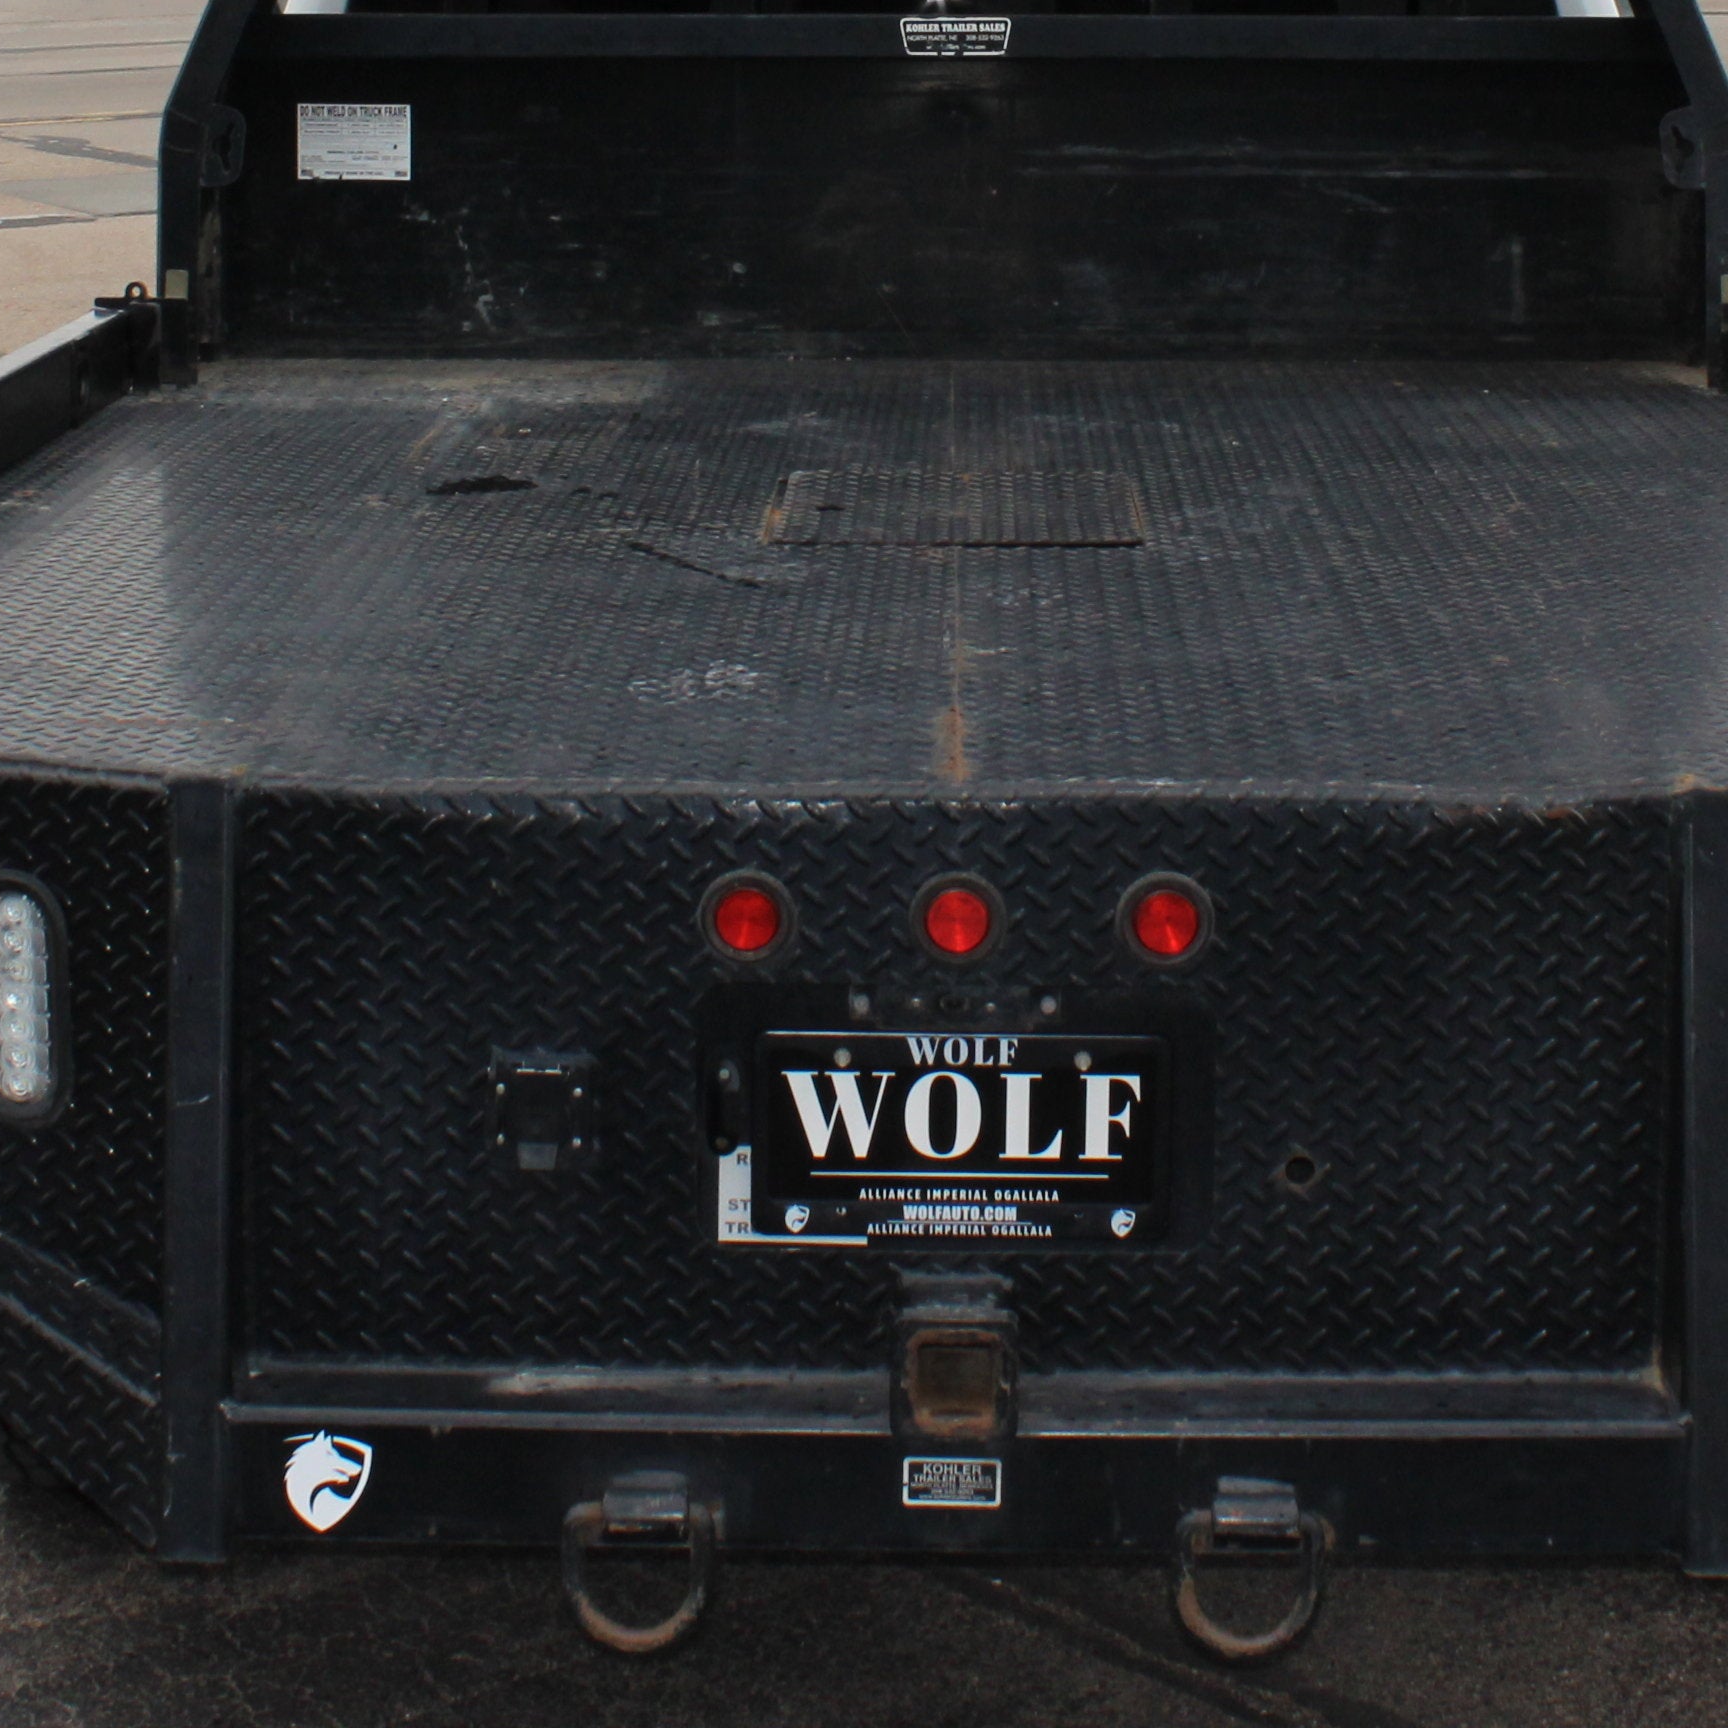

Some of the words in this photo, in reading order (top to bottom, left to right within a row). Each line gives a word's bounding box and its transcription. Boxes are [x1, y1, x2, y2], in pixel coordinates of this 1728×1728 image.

[905, 23, 940, 33] KOHLER
[941, 23, 978, 33] TRAILER
[979, 23, 1006, 33] SALES
[300, 105, 309, 117] DO
[311, 105, 325, 117] NOT
[327, 105, 345, 117] WELD
[347, 106, 357, 117] ON
[360, 106, 382, 117] TRUCK
[384, 106, 407, 118] FRAME
[906, 1037, 1018, 1066] WOLF
[781, 1071, 1141, 1159] WOLF
[859, 1188, 921, 1201] ALLIANCE
[927, 1189, 988, 1201] IMPERIAL
[994, 1190, 1059, 1202] OGALLALA
[903, 1205, 1017, 1222] WOLFAUTO.COM
[867, 1223, 924, 1235] ALLIANCE
[929, 1224, 986, 1236] IMPERIAL
[992, 1225, 1052, 1237] OGALLALA
[923, 1463, 981, 1474] KOHLER
[913, 1474, 956, 1483] TRAILER
